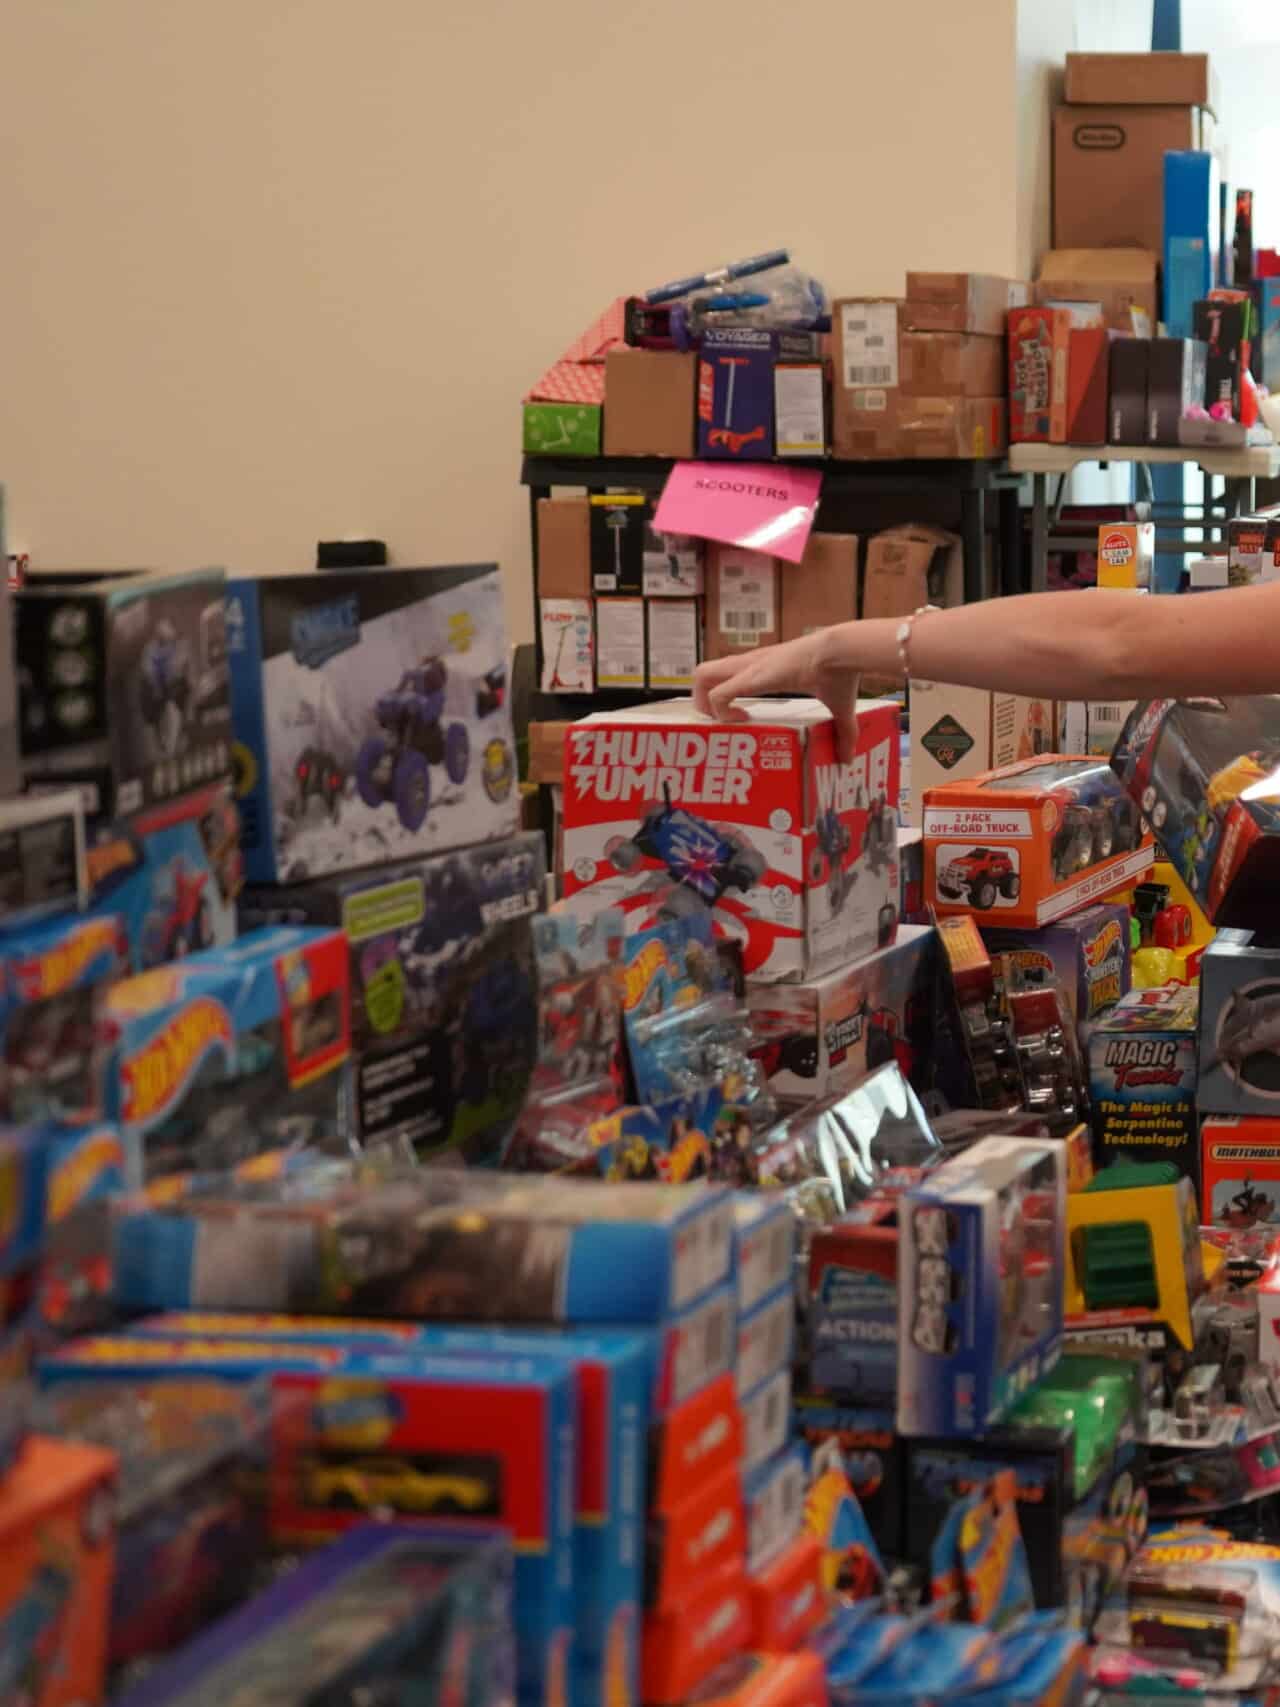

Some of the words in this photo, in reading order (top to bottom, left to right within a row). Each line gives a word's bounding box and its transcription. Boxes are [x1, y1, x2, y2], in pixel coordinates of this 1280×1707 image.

[704, 329, 770, 342] VOYAGER
[695, 478, 789, 501] SCOOTERS
[570, 730, 758, 770] THUNDER
[760, 757, 793, 770] CLUB
[570, 766, 753, 804] TUMBLER
[955, 813, 962, 822] 2
[964, 813, 992, 822] PACK
[930, 823, 983, 834] OFF-ROAD
[986, 823, 1020, 833] TRUCK
[1104, 1039, 1178, 1066] MAGIC
[1101, 1102, 1125, 1113] The
[1129, 1102, 1172, 1114] Magic
[1106, 1117, 1184, 1130] Serpentine
[1103, 1132, 1188, 1146] Technology!
[818, 1319, 897, 1340] ACTION
